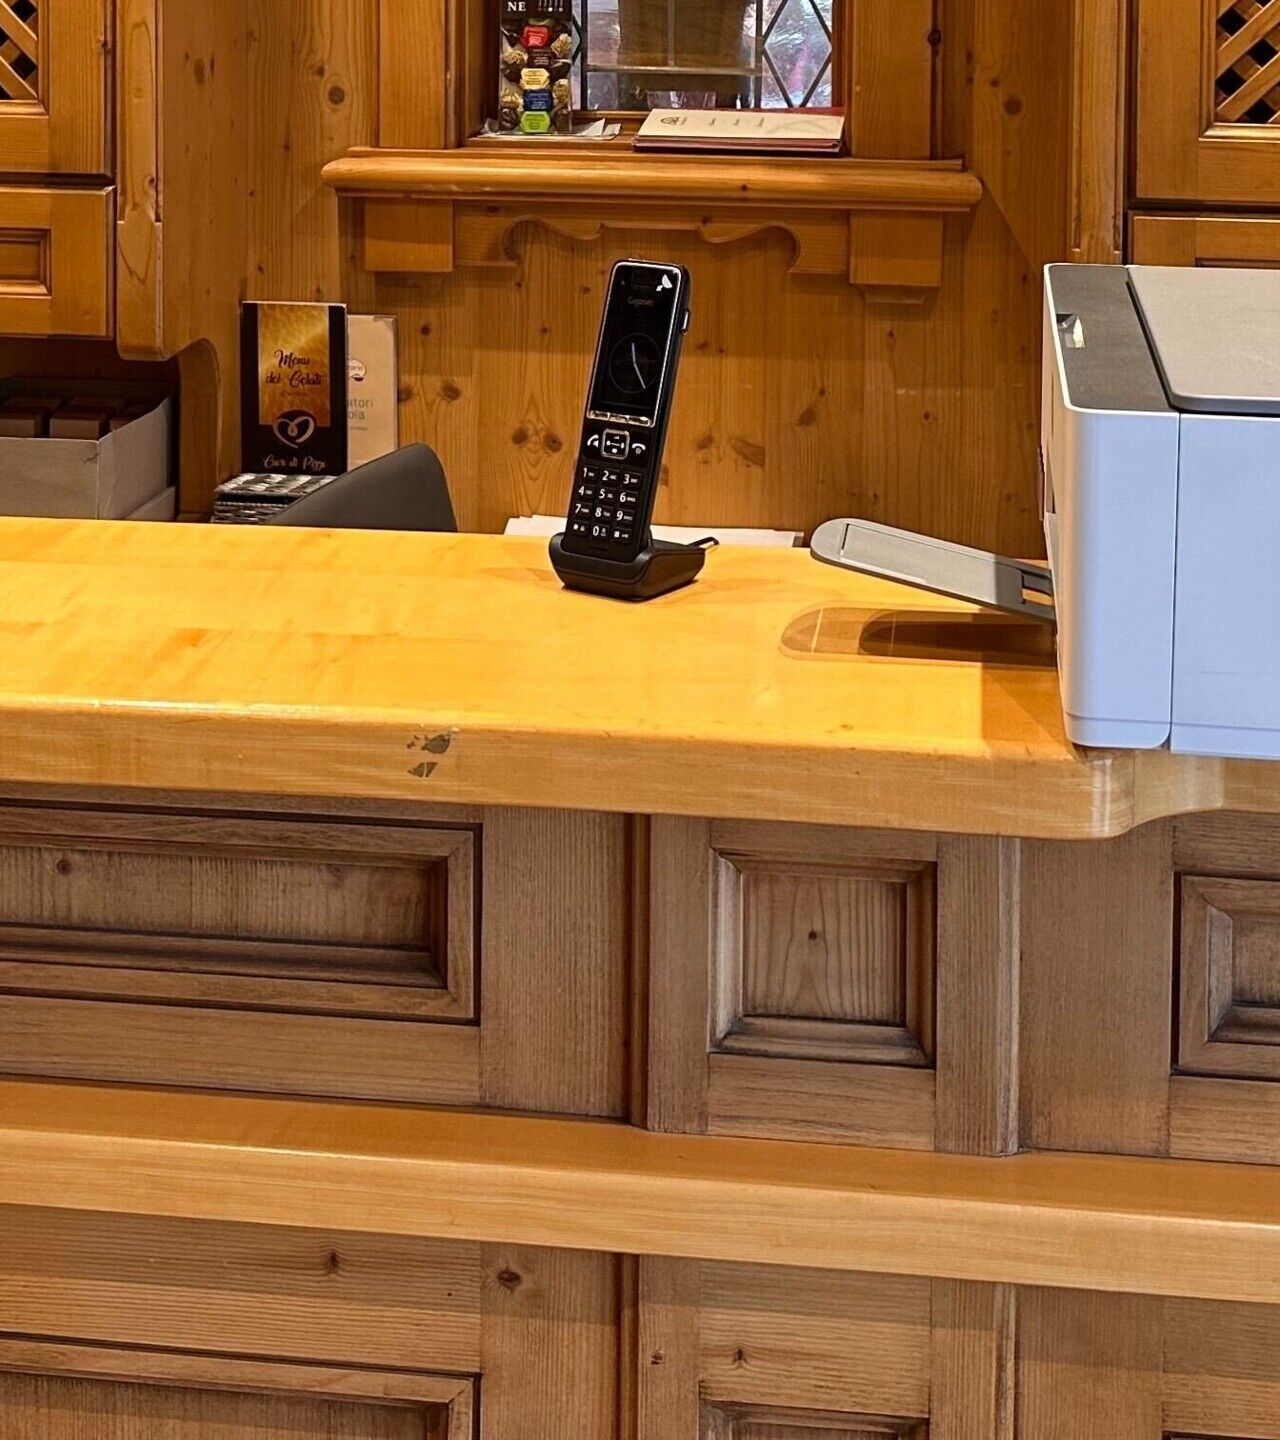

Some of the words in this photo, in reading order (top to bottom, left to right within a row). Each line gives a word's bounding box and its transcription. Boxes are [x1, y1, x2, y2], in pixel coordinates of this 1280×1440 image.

[507, 1, 526, 12] NE
[583, 467, 588, 478] 1
[602, 470, 609, 481] 2
[623, 474, 630, 484] 3
[578, 485, 585, 496] 4
[599, 488, 605, 499] 5
[620, 492, 626, 502] 6
[575, 503, 582, 513] 7
[595, 507, 602, 517] 8
[616, 510, 623, 521] 9
[593, 525, 599, 536] 0
